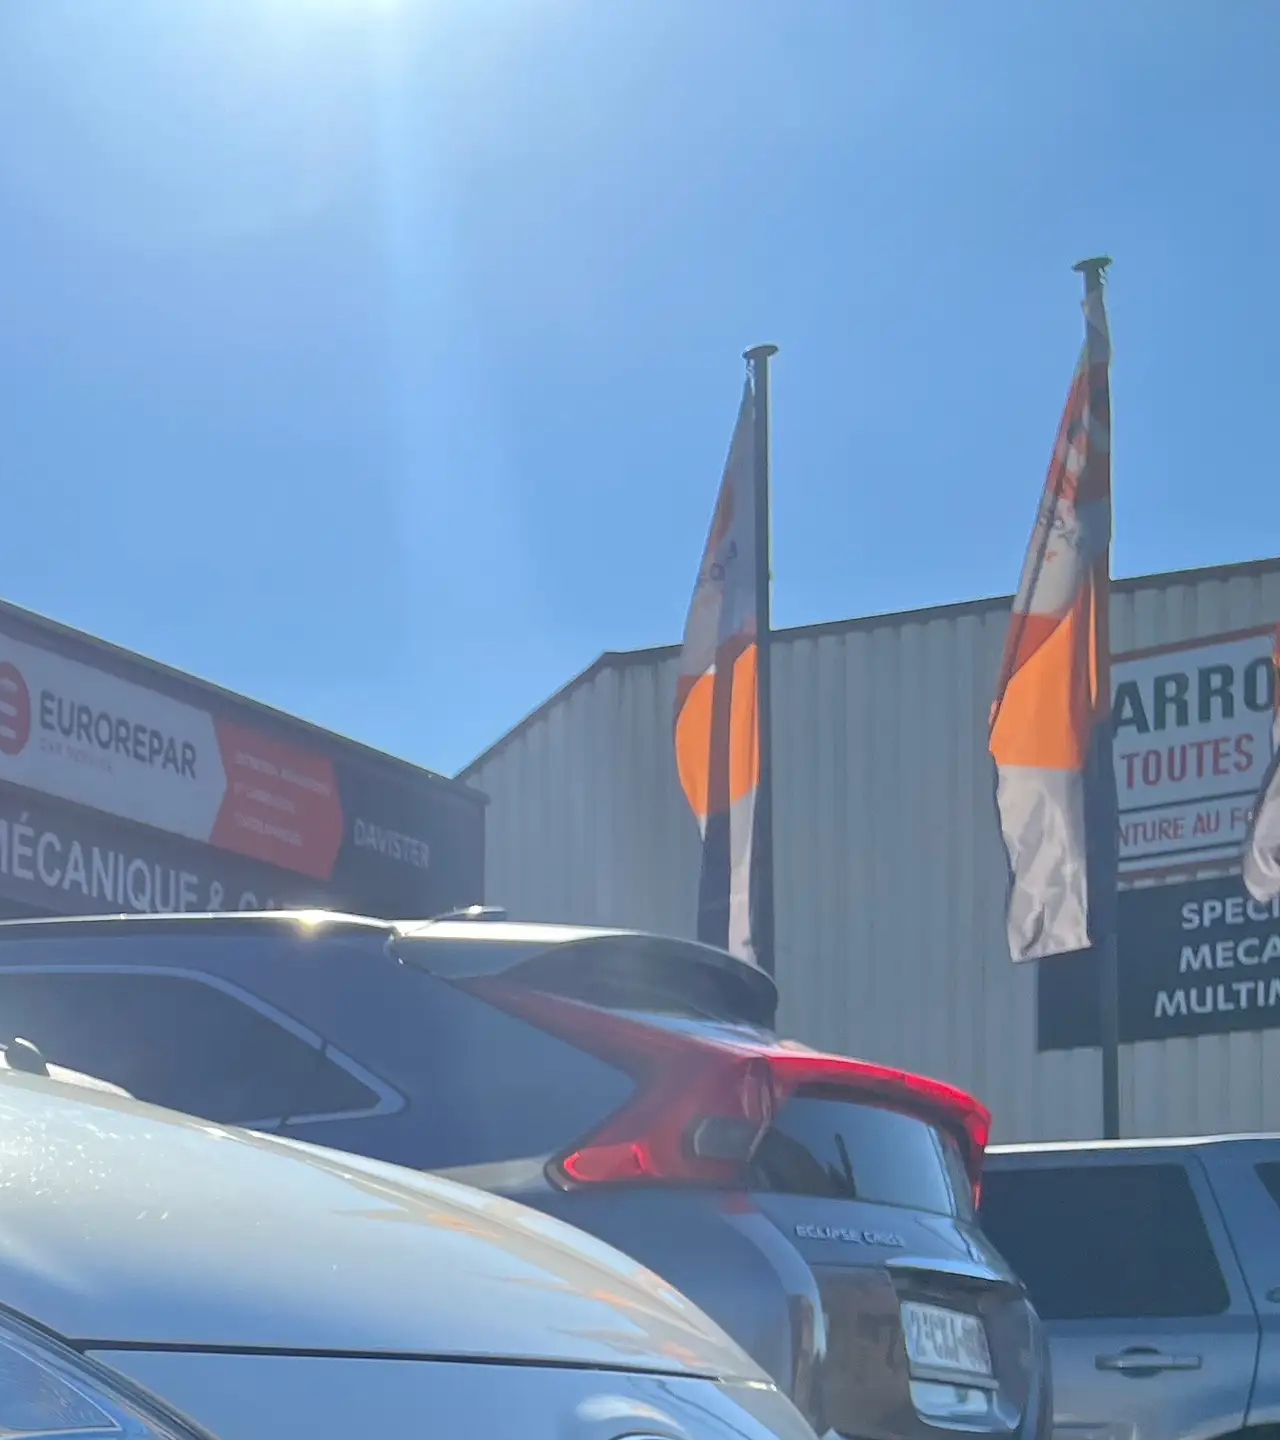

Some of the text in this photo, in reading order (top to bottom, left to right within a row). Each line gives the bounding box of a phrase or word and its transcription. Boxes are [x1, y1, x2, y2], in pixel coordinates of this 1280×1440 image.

[40, 689, 197, 780] EUROREPAR
[1120, 733, 1255, 790] TOUTES
[354, 818, 430, 870] DAVISTER
[1192, 808, 1221, 836] AU
